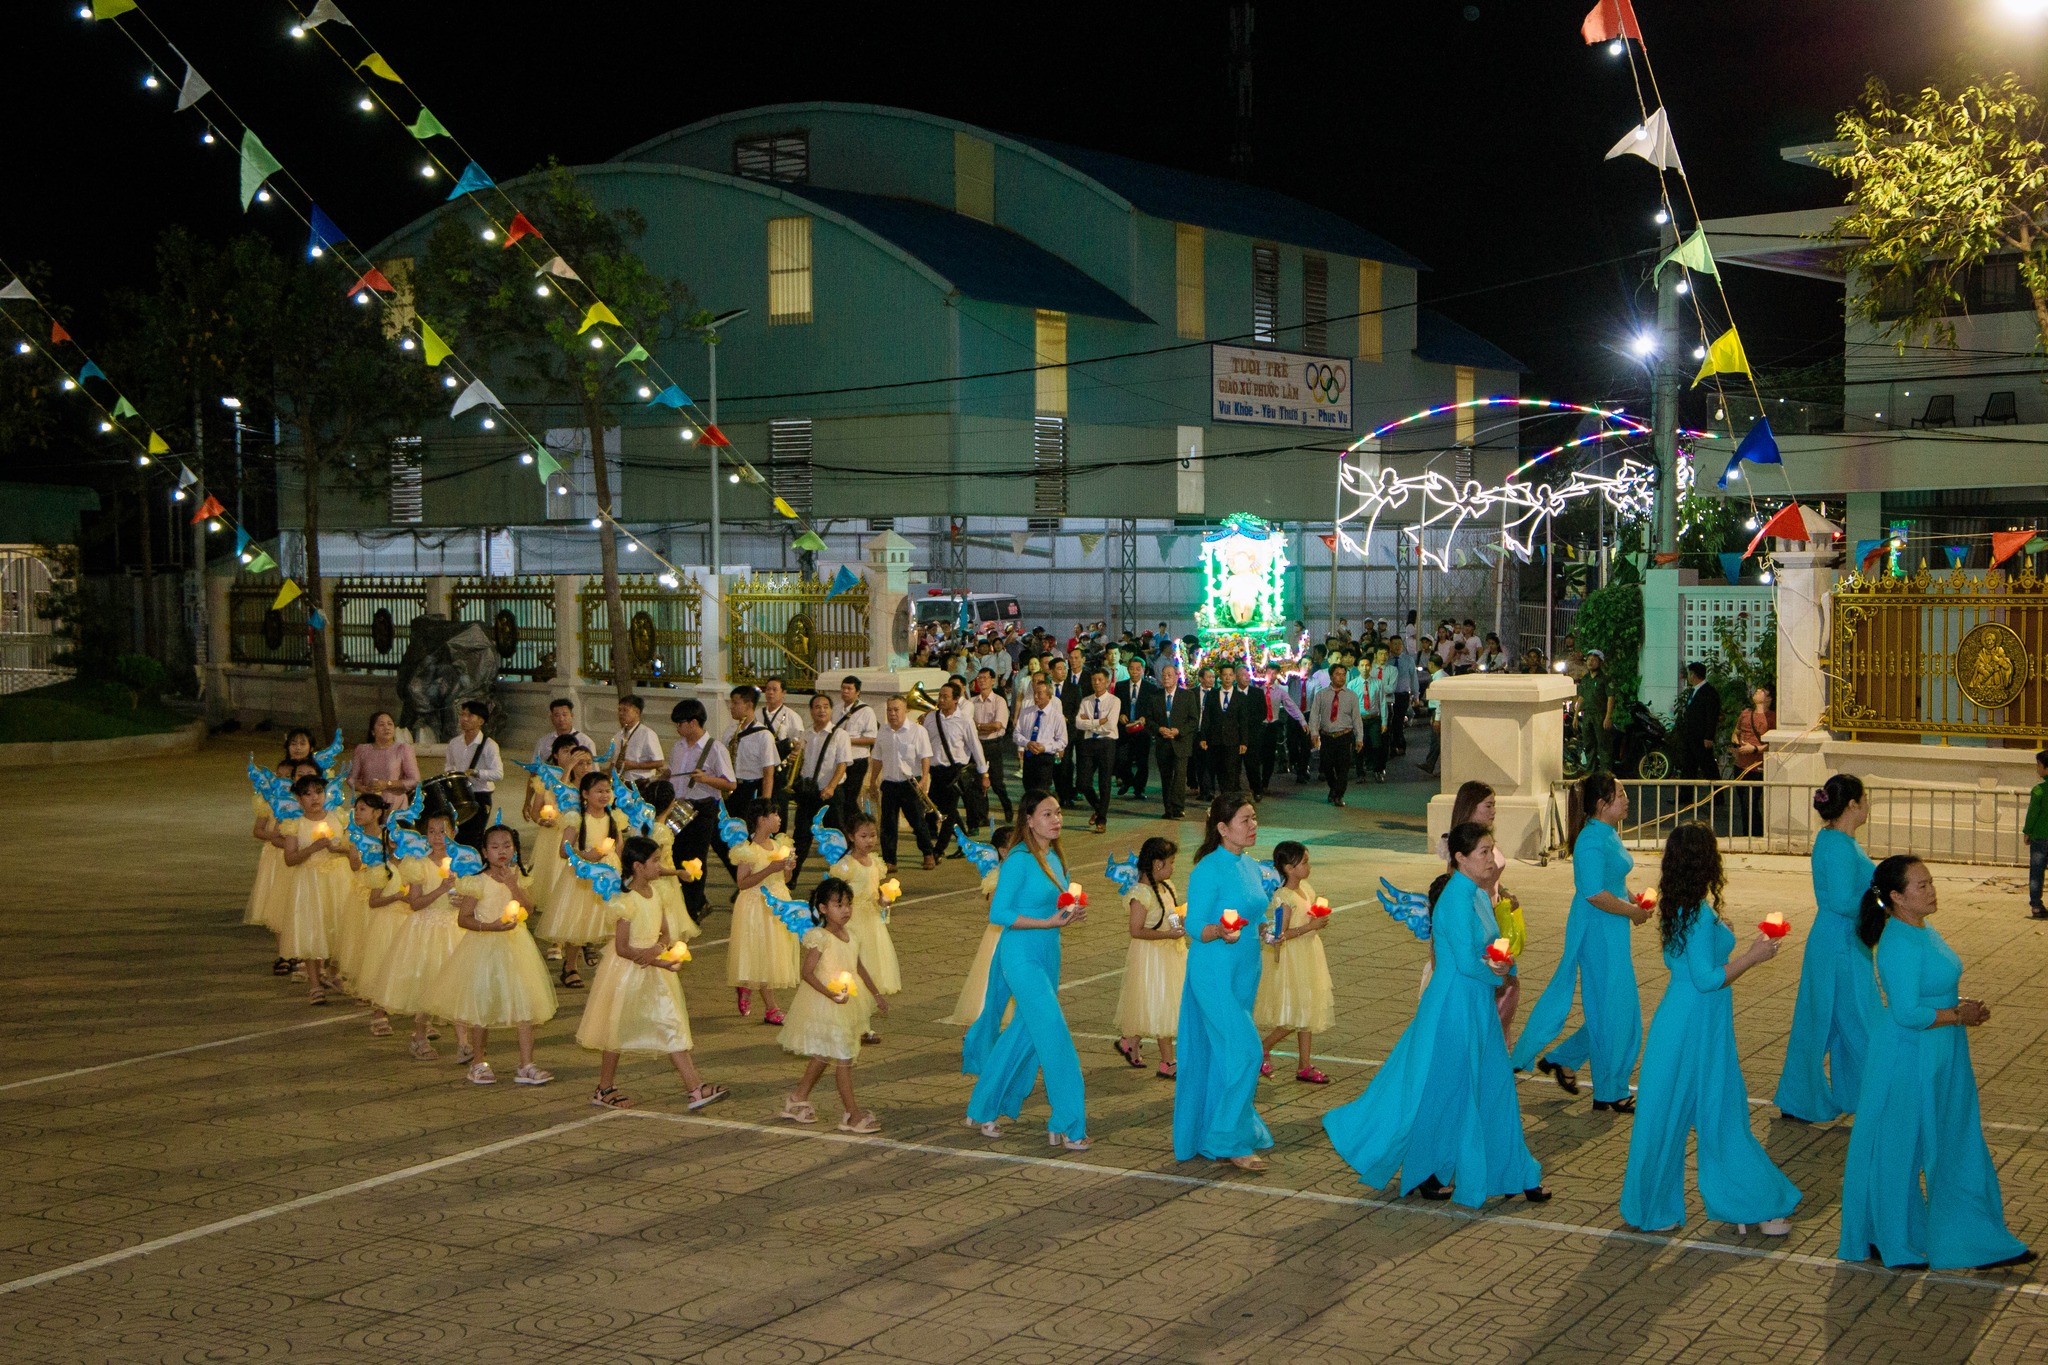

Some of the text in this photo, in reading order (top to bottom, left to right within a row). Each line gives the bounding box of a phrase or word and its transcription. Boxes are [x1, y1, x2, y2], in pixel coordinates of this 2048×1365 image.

[1232, 351, 1289, 378] TUỔI TRẺ
[1218, 376, 1238, 394] GIÁO
[1282, 383, 1299, 400] LÂM
[1219, 401, 1230, 414] Vui
[1261, 404, 1276, 418] Yêu
[1318, 409, 1336, 426] Phục
[1338, 411, 1347, 426] Vụ
